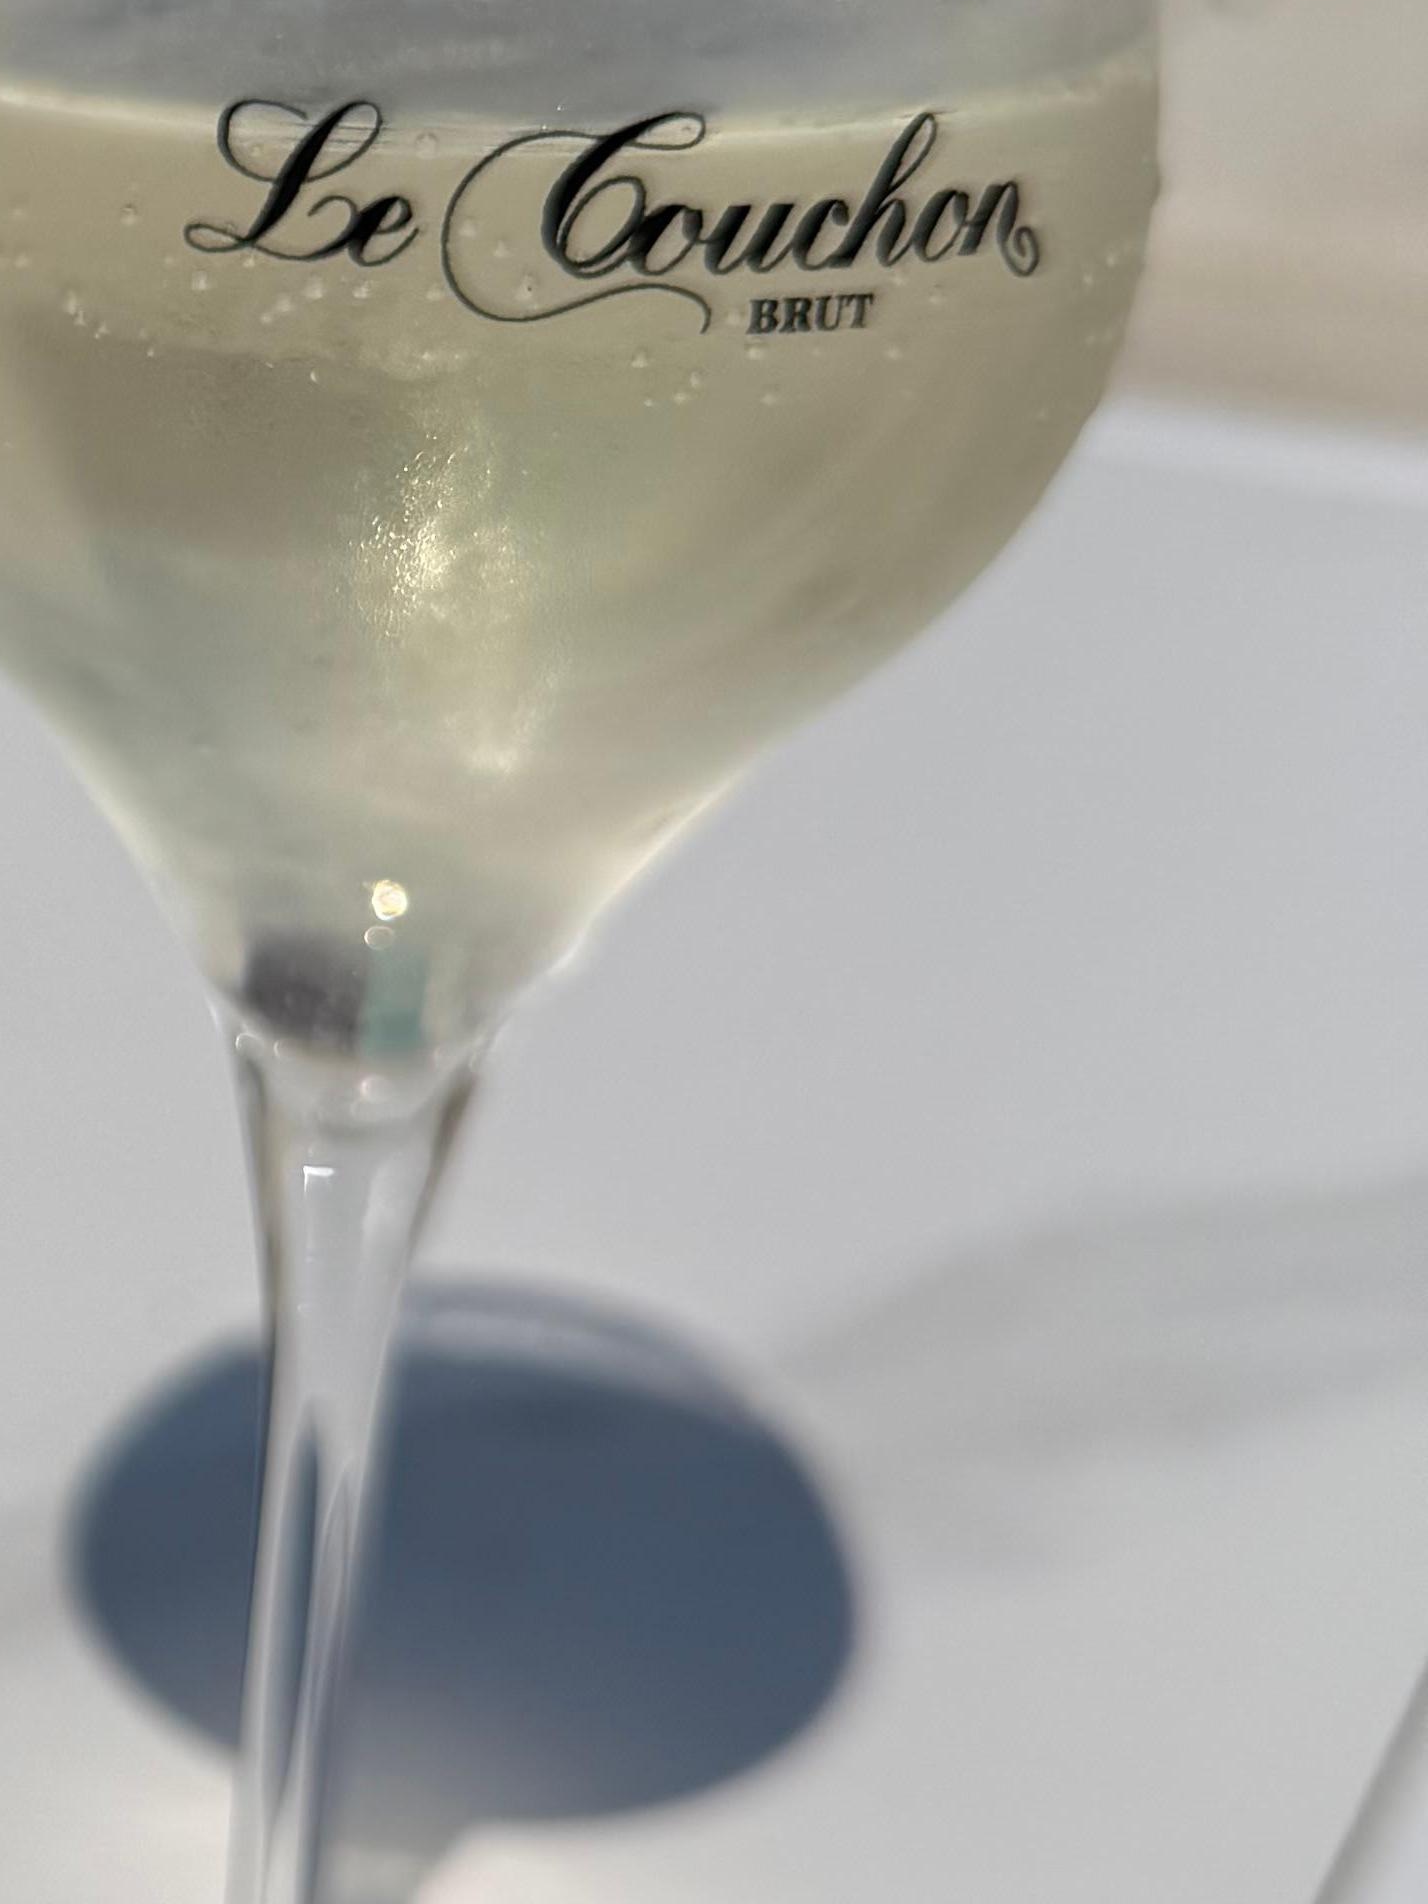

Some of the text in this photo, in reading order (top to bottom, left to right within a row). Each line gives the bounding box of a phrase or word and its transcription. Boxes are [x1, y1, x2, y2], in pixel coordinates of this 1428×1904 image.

[184, 98, 1040, 334] Le Couchon
[746, 294, 875, 335] BRUT
